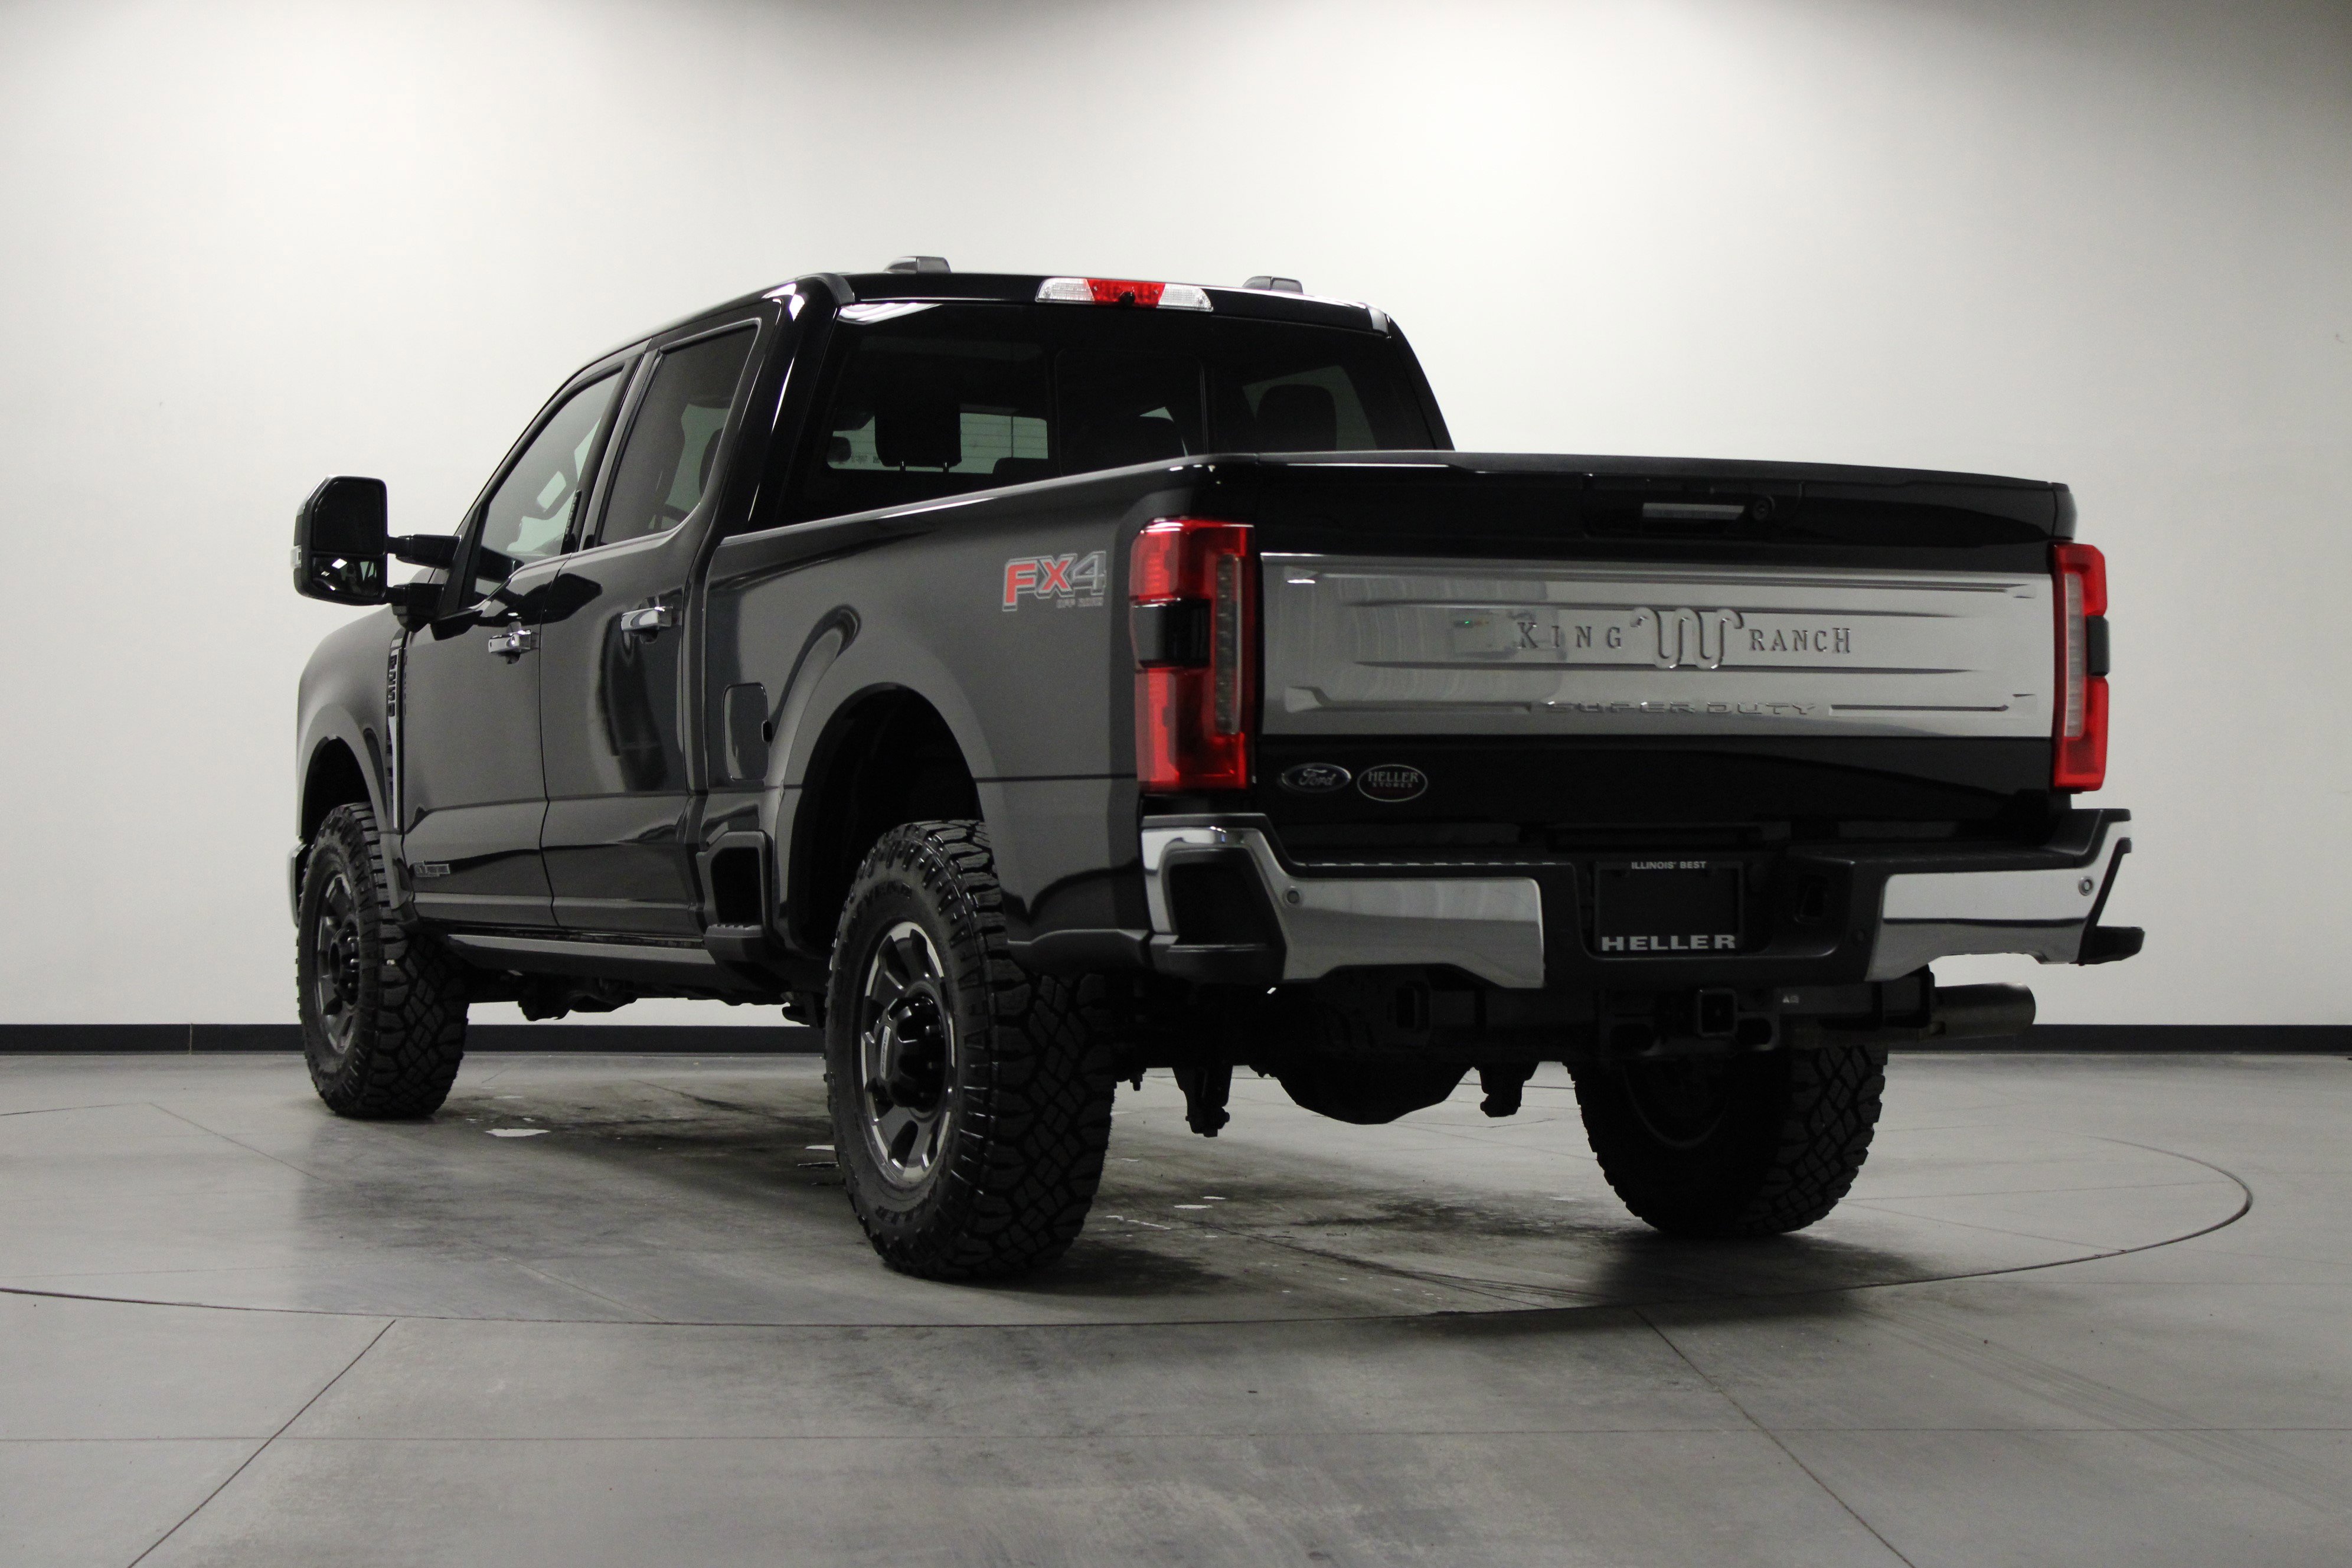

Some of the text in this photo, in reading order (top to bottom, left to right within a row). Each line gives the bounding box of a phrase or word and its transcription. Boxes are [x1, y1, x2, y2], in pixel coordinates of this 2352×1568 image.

[1002, 550, 1107, 612] FX4
[1517, 622, 1851, 654] KING RANCH
[1706, 701, 1816, 715] DUTY
[1299, 768, 1337, 786] Ford
[1368, 771, 1419, 783] HELLER
[1680, 861, 1707, 869] BEST
[1602, 934, 1736, 951] HELLER
